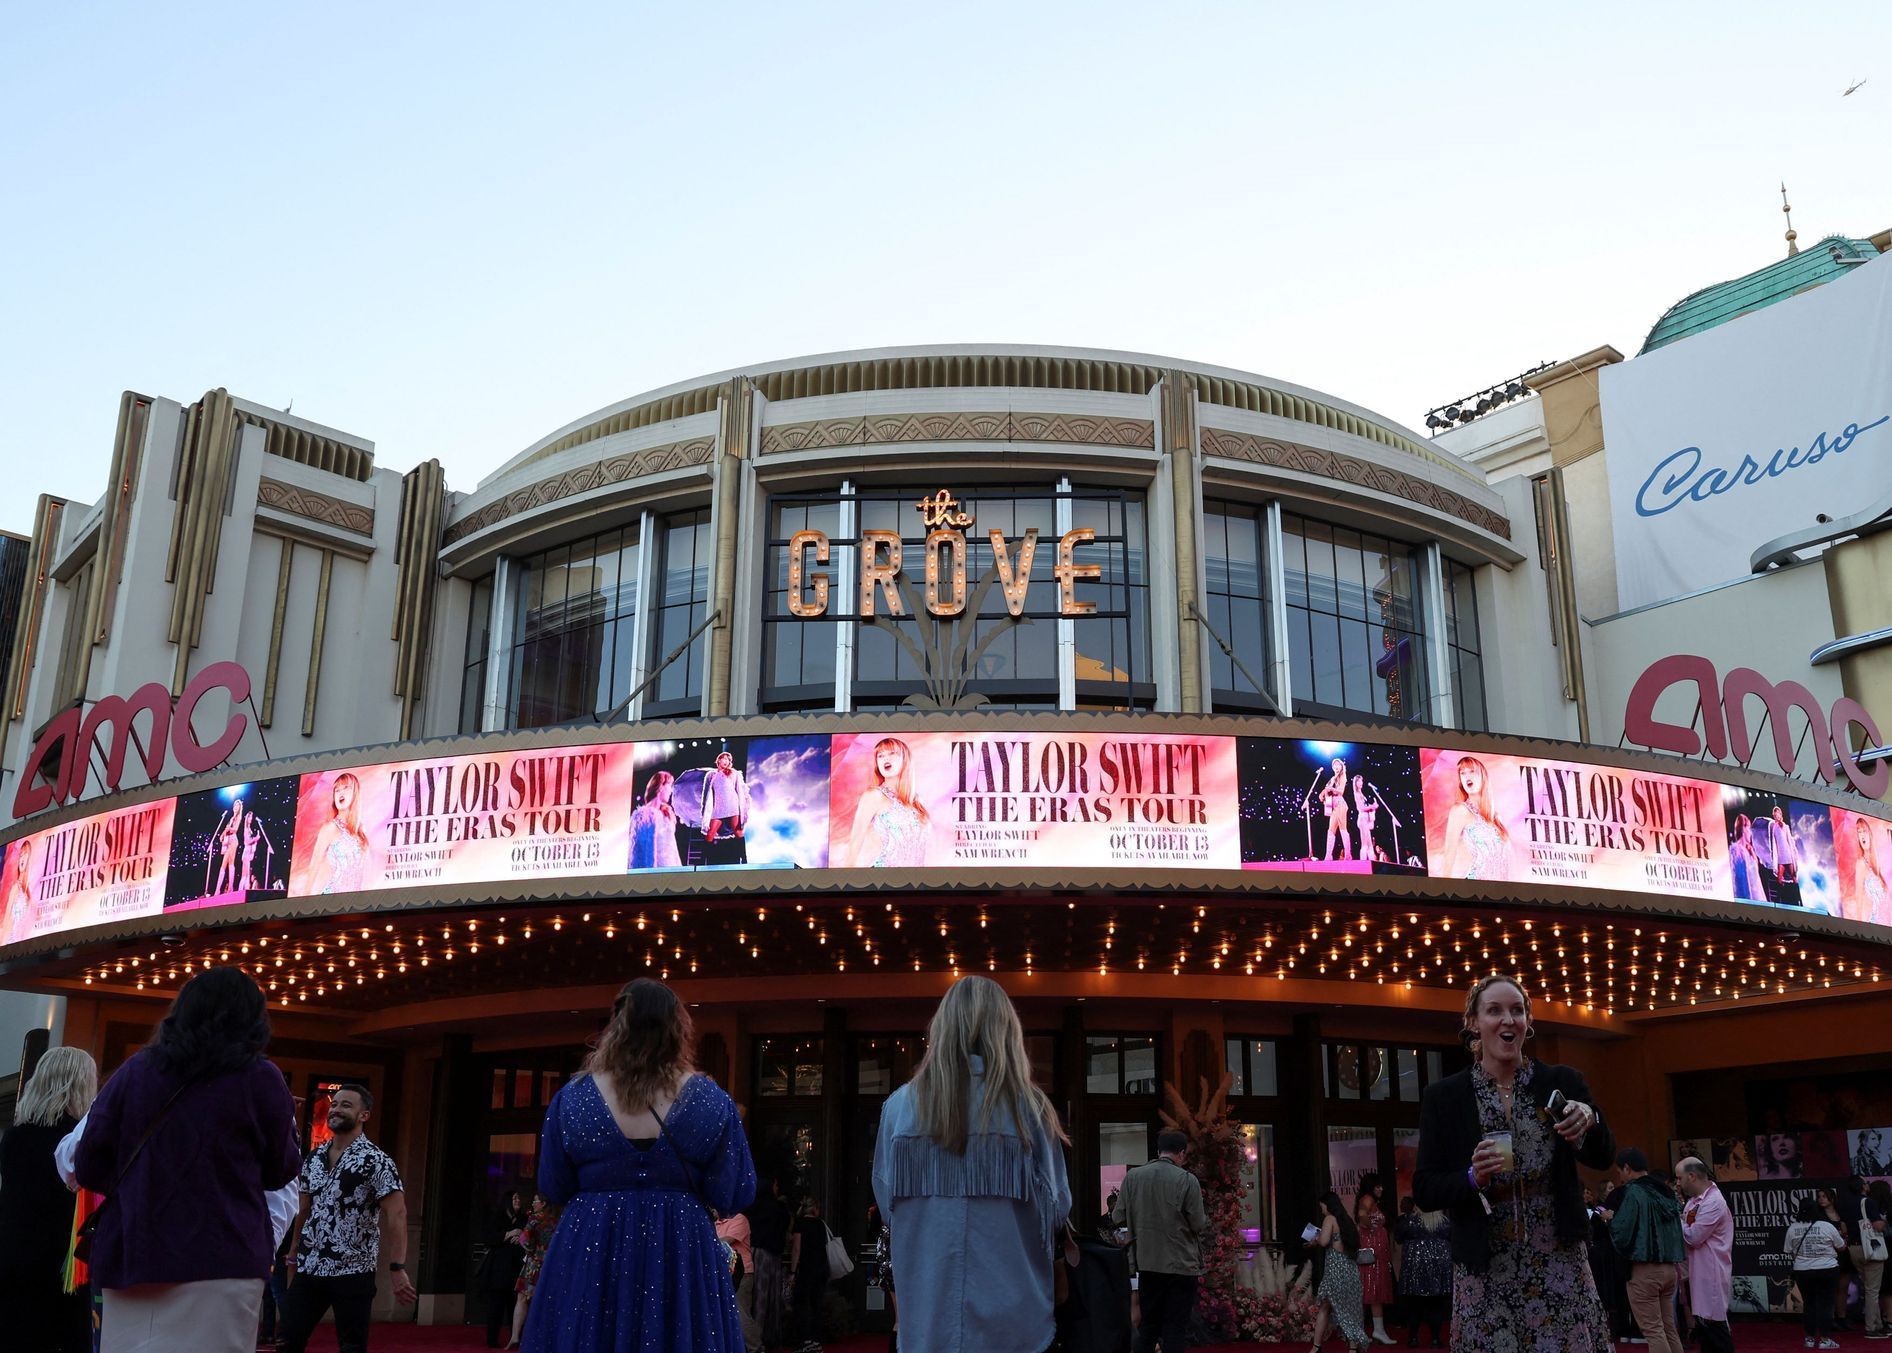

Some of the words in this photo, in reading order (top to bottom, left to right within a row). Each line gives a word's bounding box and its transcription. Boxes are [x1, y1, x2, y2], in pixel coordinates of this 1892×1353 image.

[1635, 415, 1890, 517] Caruso
[915, 488, 975, 530] the
[787, 528, 1101, 620] GROVE
[389, 761, 501, 819] TAYLOR
[508, 753, 606, 811] SWIFT
[951, 740, 1090, 794] TAYLOR
[1099, 741, 1207, 795] SWIFT
[951, 796, 1019, 823] THE
[1027, 796, 1113, 823] ERAS
[1121, 797, 1208, 825] TOUR
[1519, 766, 1627, 824] TAYLOR
[1632, 777, 1704, 833] SWIFT
[42, 821, 101, 879] TAYLOR
[102, 808, 161, 864] SWIFT
[387, 818, 439, 846] THE
[445, 811, 516, 842] ERAS
[524, 807, 602, 836] TOUR
[954, 830, 1002, 841] TAYLOR
[1004, 830, 1041, 841] SWIFT
[1109, 834, 1189, 851] OCTOBER
[1195, 835, 1209, 851] 13
[1525, 817, 1578, 846] THE
[1584, 823, 1645, 852] ERAS
[1650, 830, 1710, 860] TOUR
[511, 843, 582, 863] OCTOBER
[587, 842, 600, 858] 13
[954, 848, 978, 858] SAM
[981, 848, 1027, 858] WRENCH
[1645, 862, 1700, 882] OCTOBER
[39, 874, 65, 901] THE
[67, 865, 106, 894] ERAS
[109, 856, 154, 885] TOUR
[1730, 1190, 1788, 1215] TAYLOR
[1733, 1215, 1761, 1228] THE
